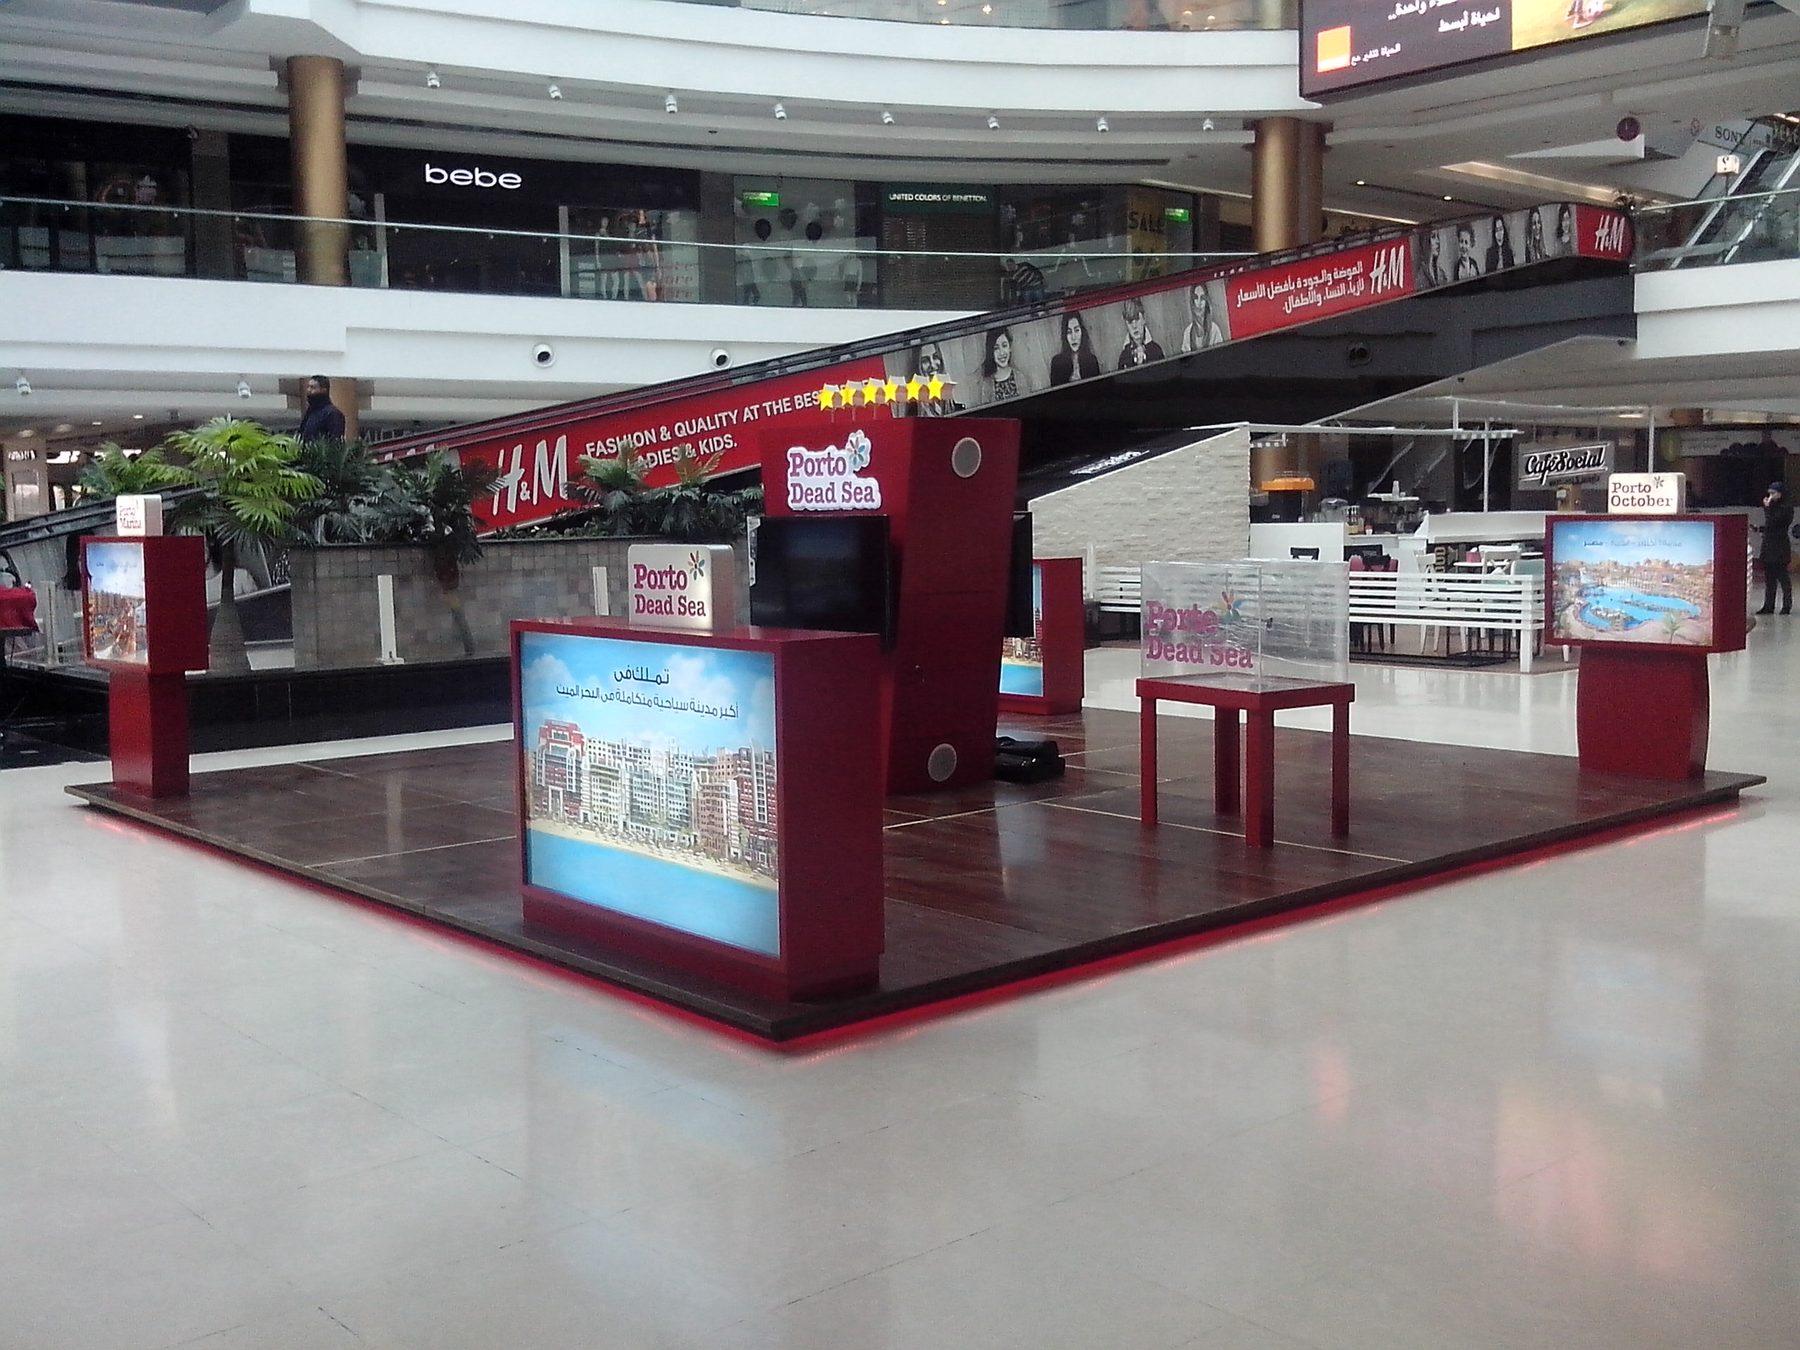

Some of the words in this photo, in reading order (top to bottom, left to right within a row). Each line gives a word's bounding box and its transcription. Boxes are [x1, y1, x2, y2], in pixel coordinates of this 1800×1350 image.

[425, 163, 522, 189] bebe
[889, 193, 913, 201] UNITED
[915, 193, 941, 201] COLORS
[1595, 214, 1625, 253] H&M
[1370, 245, 1405, 294] H&M
[586, 428, 656, 457] FASHION
[659, 425, 672, 442] &
[674, 409, 738, 437] QUALITY
[743, 404, 760, 422] AT
[763, 401, 792, 417] THE
[795, 391, 824, 411] BES
[637, 446, 682, 469] ADIES
[686, 443, 697, 458] &
[699, 433, 738, 455] KIDS.
[493, 435, 568, 516] H&M
[790, 452, 846, 477] Porto
[790, 482, 837, 504] Dead
[841, 481, 875, 504] Sea
[1610, 494, 1673, 507] October
[1611, 482, 1651, 494] Porto
[633, 564, 688, 590] Porto
[634, 594, 674, 616] Dead
[678, 594, 706, 617] Sea
[1145, 600, 1219, 634] Porto
[1146, 635, 1204, 664] Dead
[1210, 641, 1254, 669] Sea
